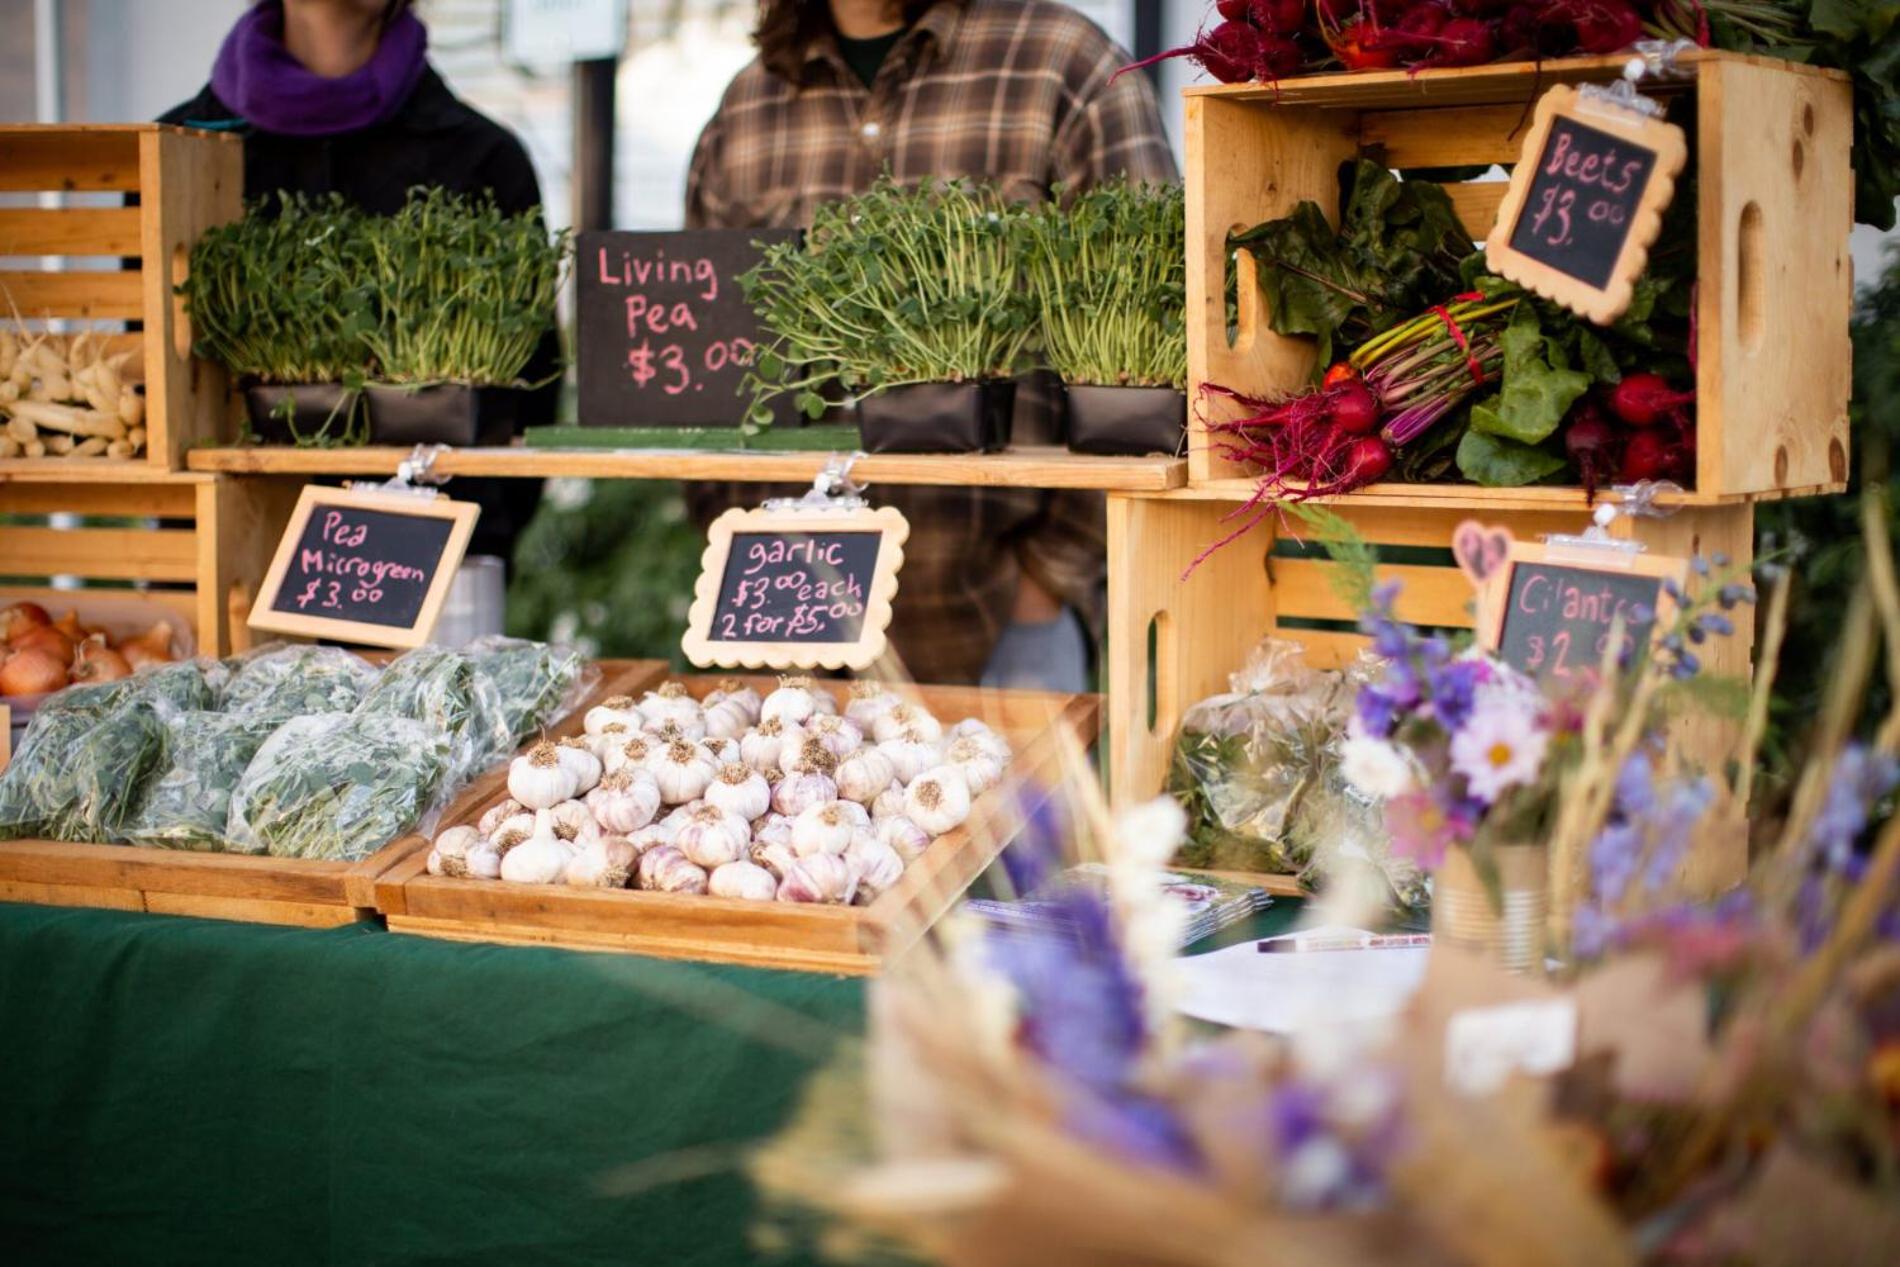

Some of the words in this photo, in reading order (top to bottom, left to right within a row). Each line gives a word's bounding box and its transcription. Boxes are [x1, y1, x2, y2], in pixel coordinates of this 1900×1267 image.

[1546, 132, 1642, 193] Beets
[599, 247, 718, 300] Living
[625, 294, 698, 339] Pea
[323, 510, 368, 547] Pea
[301, 548, 425, 588] Microgreen
[743, 538, 844, 575] garlic
[796, 573, 863, 601] each
[721, 613, 738, 639] 2
[743, 613, 784, 636] for
